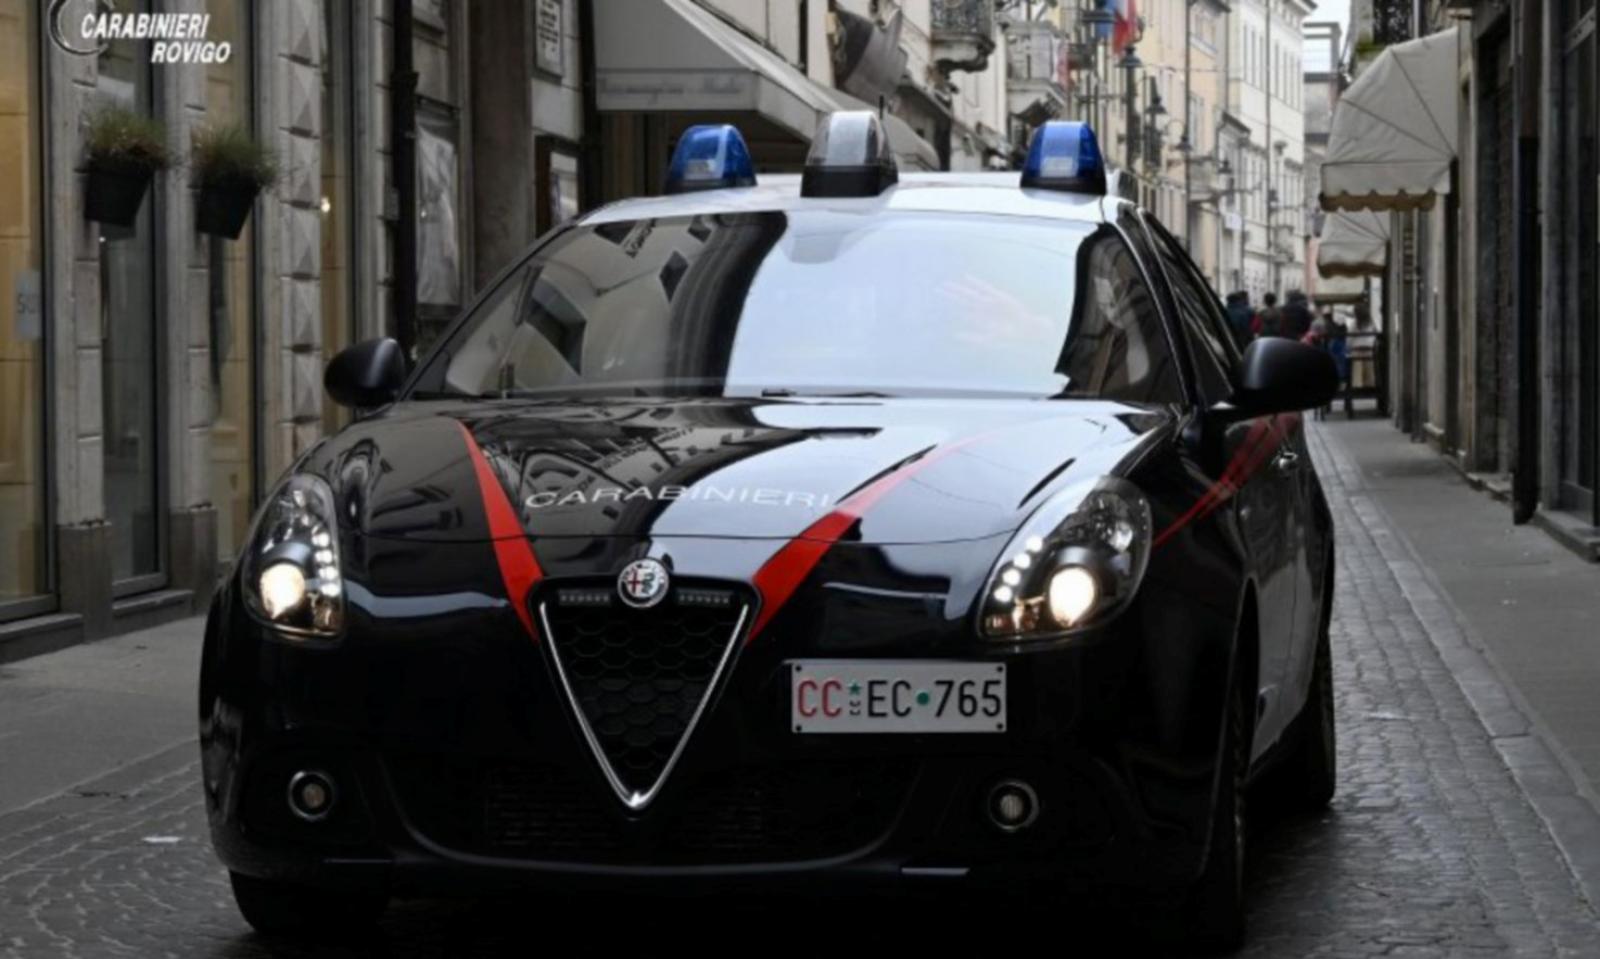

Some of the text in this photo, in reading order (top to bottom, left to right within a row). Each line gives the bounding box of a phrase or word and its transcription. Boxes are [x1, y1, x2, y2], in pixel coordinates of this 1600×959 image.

[525, 485, 831, 508] CARABINIERI
[797, 679, 843, 718] CC
[867, 679, 912, 718] EC
[934, 679, 1002, 718] 765
